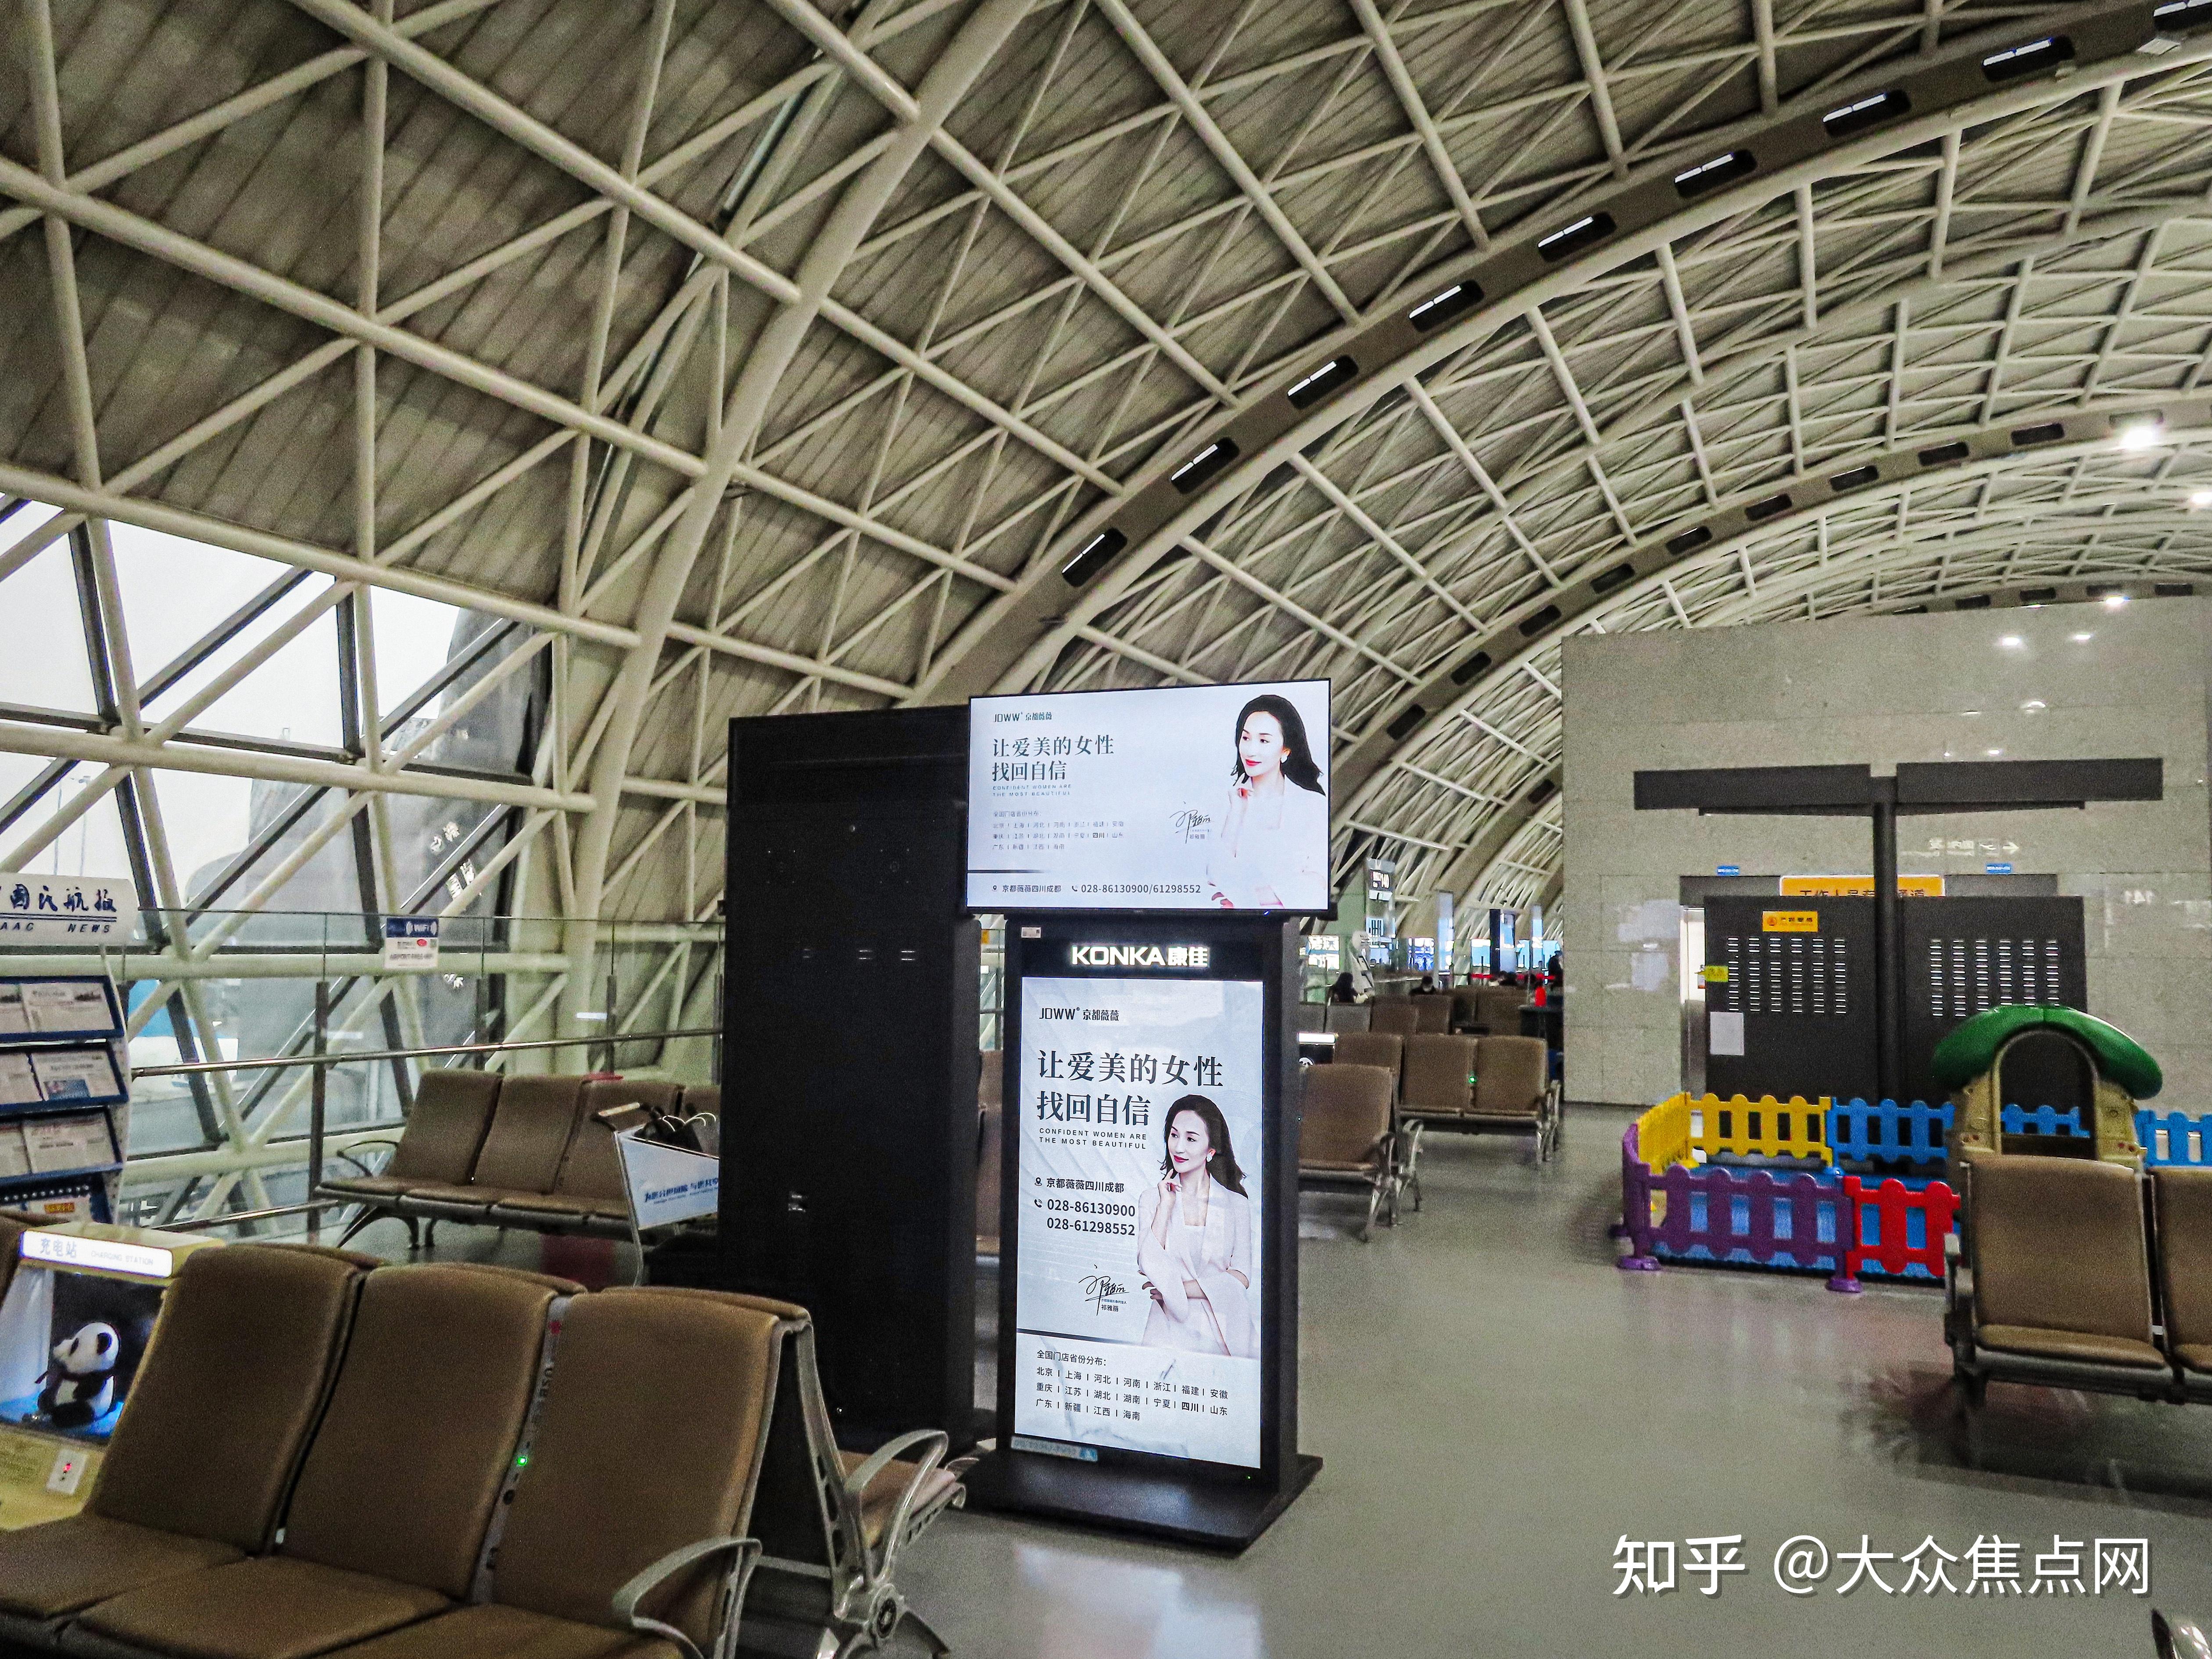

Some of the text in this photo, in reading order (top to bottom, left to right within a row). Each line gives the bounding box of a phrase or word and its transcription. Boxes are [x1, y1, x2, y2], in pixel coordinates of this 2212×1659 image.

[993, 735, 1114, 757] 让爱美的女性
[992, 760, 1067, 781] 找回自信
[0, 883, 117, 912] 国民航报
[1081, 884, 1201, 894] 028-86130900/61298552
[68, 923, 110, 933] NEWS
[1072, 946, 1209, 967] KONKA 康佳
[1083, 1009, 1119, 1021] 京都薇薇
[1038, 1050, 1224, 1087] 让爱美的女性
[1036, 1090, 1151, 1126] 找回自信
[1039, 1128, 1089, 1137] CONFIDENT
[1093, 1131, 1126, 1139] WOMEN
[1092, 1139, 1146, 1150] BEAUTIFUL
[1046, 1177, 1124, 1193] 京都薇薇四川成都
[1047, 1199, 1135, 1217] 028-86130900
[1047, 1218, 1135, 1236] 028-61298552
[125, 1256, 154, 1265] STATION
[1036, 1350, 1106, 1366] 全国门店省份分布:
[1036, 1367, 1228, 1399] 北京 上海 河北 河南 浙江 福建 安徽
[1036, 1383, 1228, 1416] 重庆 江苏 湖北 湖南 宁夏 四川 山东
[1035, 1398, 1140, 1421] 广东 新疆 江西 海南
